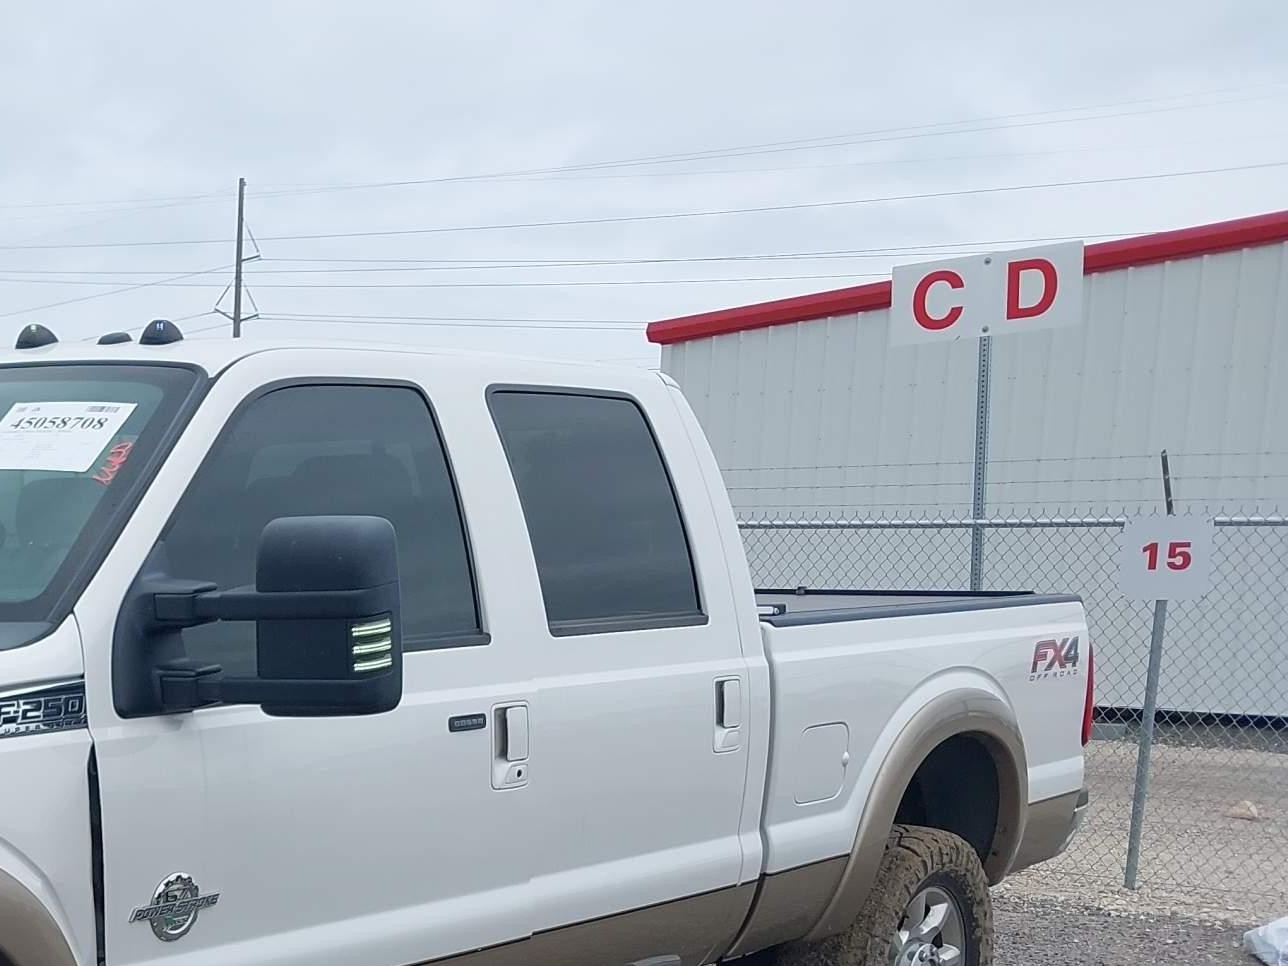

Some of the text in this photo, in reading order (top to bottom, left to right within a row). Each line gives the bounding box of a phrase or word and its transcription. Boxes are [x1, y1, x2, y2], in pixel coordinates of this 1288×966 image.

[912, 257, 1058, 331] C D
[10, 415, 109, 431] 45058708
[1142, 541, 1192, 571] 15
[1030, 635, 1080, 674] FX4
